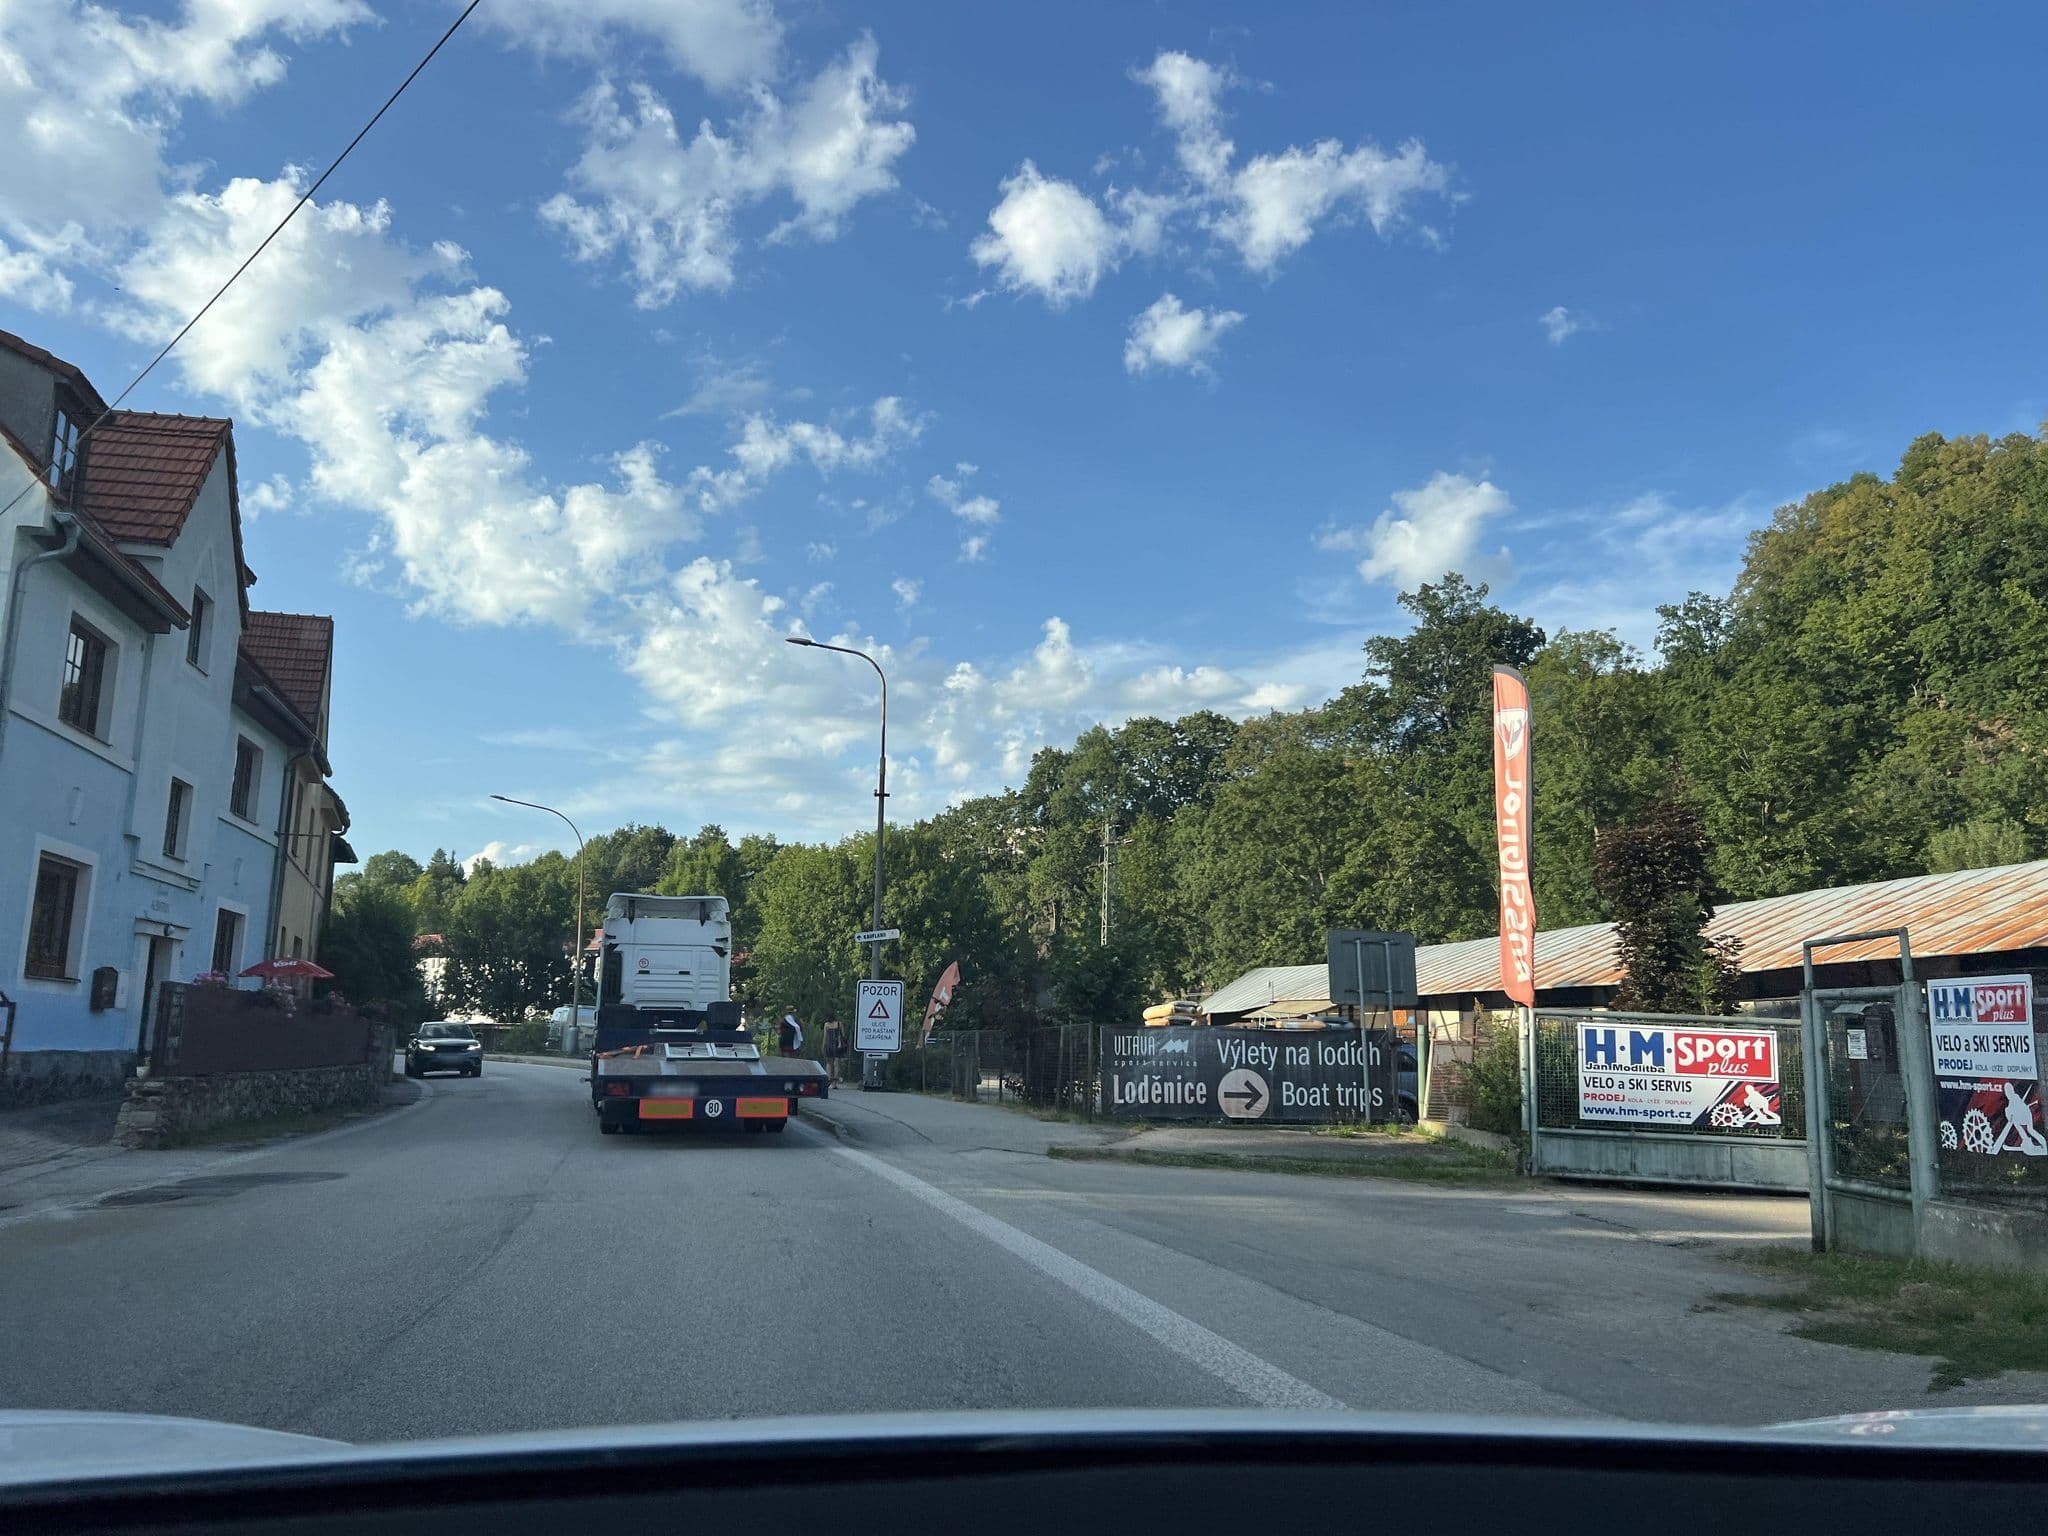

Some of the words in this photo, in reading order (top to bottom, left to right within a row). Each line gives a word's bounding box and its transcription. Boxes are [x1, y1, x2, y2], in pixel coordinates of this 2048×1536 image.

[862, 985, 898, 996] POZOR
[1935, 1035, 1961, 1052] VELO
[1964, 1039, 1971, 1052] a
[1973, 1035, 1990, 1053] SKI
[1993, 1035, 2030, 1054] SERVIS
[1217, 1038, 1278, 1071] Výlety
[1285, 1046, 1310, 1065] na
[1318, 1040, 1381, 1066] lodích
[1612, 1063, 1666, 1074] Modlitba
[1707, 1054, 1749, 1077] plus
[1938, 1058, 1973, 1071] PRODEJ
[1113, 1074, 1207, 1104] Loděnice
[1583, 1076, 1615, 1090] VELO
[1618, 1081, 1625, 1090] a
[1629, 1078, 1648, 1091] SKI
[1651, 1079, 1693, 1093] SERVIS
[1940, 1080, 2003, 1094] www.hm-sport.cz
[1282, 1081, 1330, 1106] Boat
[1336, 1081, 1383, 1112] trips
[1583, 1092, 1626, 1103] PRODEJ
[708, 1102, 720, 1114] 80
[1583, 1105, 1692, 1119] www.hm-sport.cz
